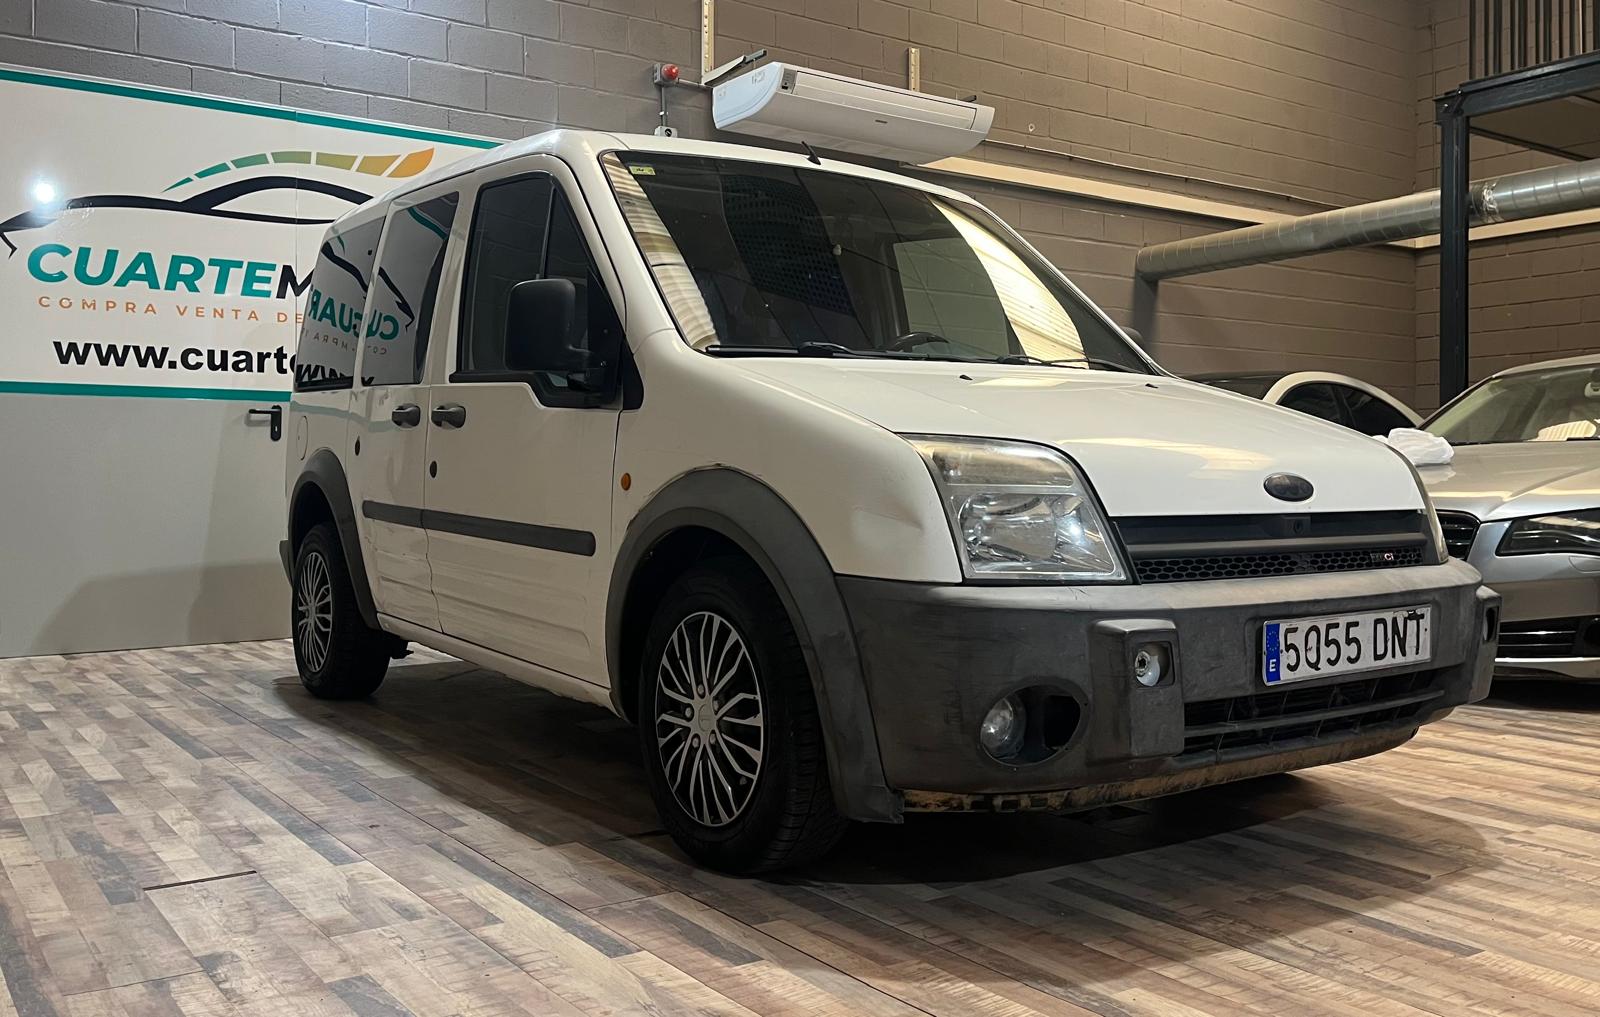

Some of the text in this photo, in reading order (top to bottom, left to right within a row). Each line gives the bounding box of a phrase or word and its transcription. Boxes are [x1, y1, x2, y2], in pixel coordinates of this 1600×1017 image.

[27, 243, 314, 299] CUARTEM
[38, 296, 157, 314] COMPRA
[176, 305, 259, 321] VENTA
[1269, 659, 1277, 672] E
[1373, 613, 1425, 661] DNT
